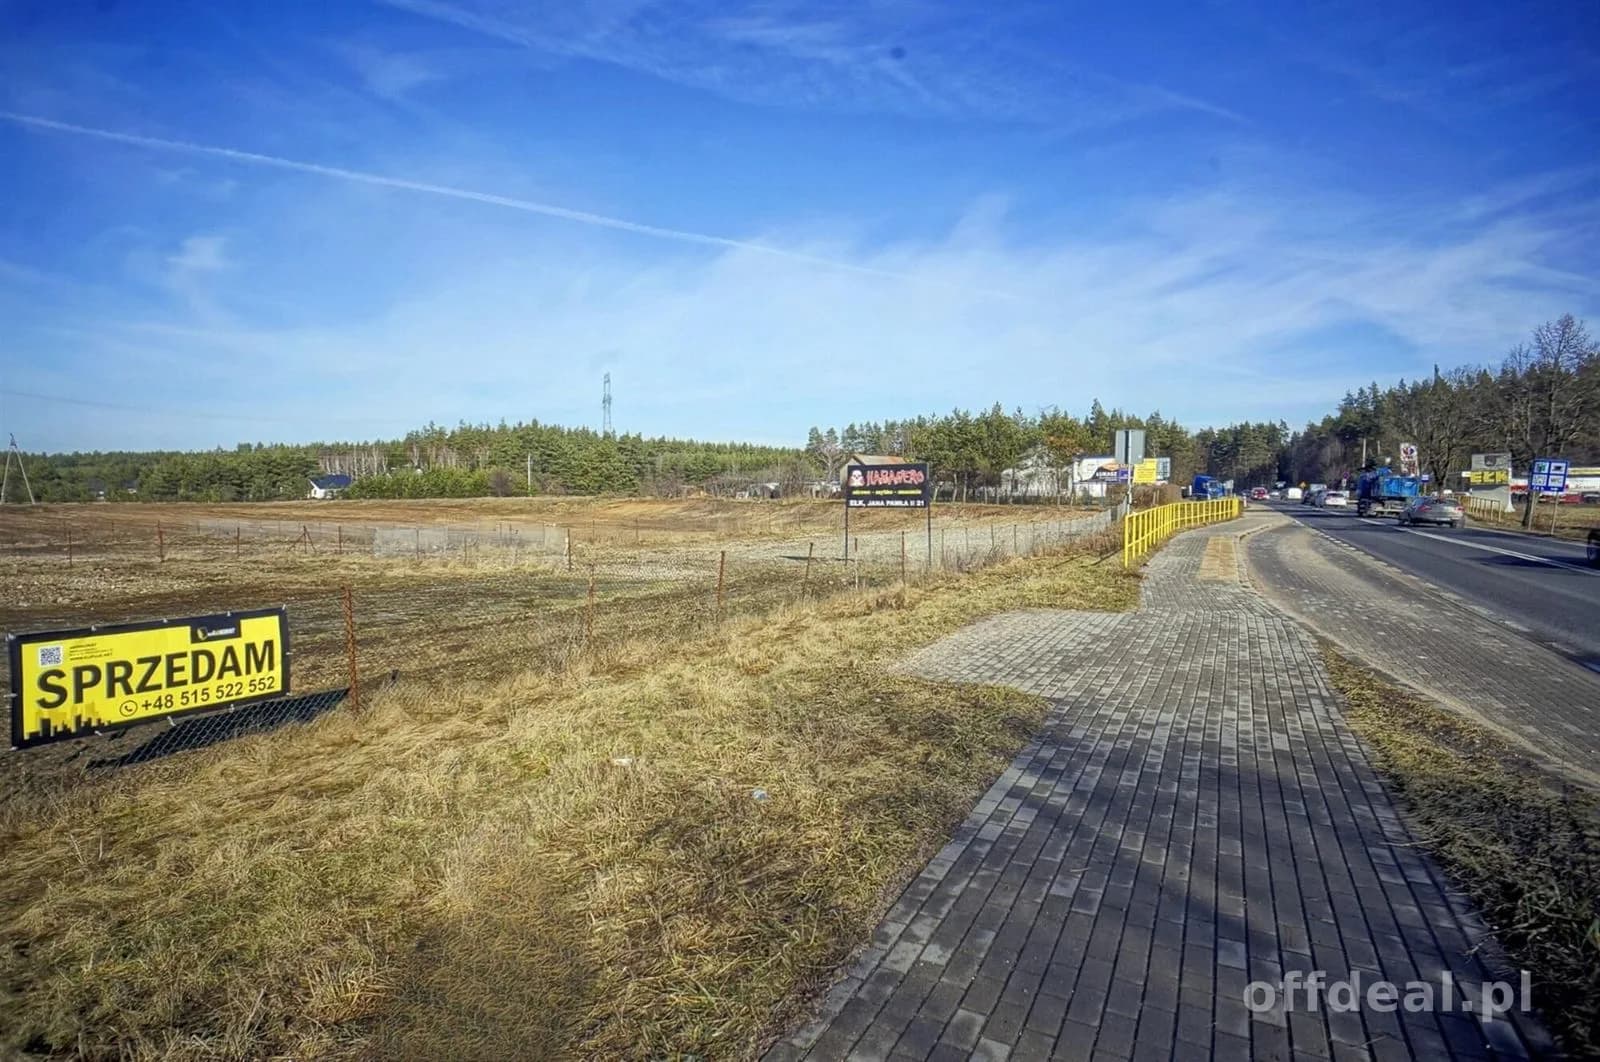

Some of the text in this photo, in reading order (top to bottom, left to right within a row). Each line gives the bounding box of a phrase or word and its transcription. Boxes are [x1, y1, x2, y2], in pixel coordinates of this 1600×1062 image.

[1471, 471, 1508, 483] EŁK
[37, 639, 275, 709] SPRZEDAM
[141, 676, 275, 712] +48 515 522 552
